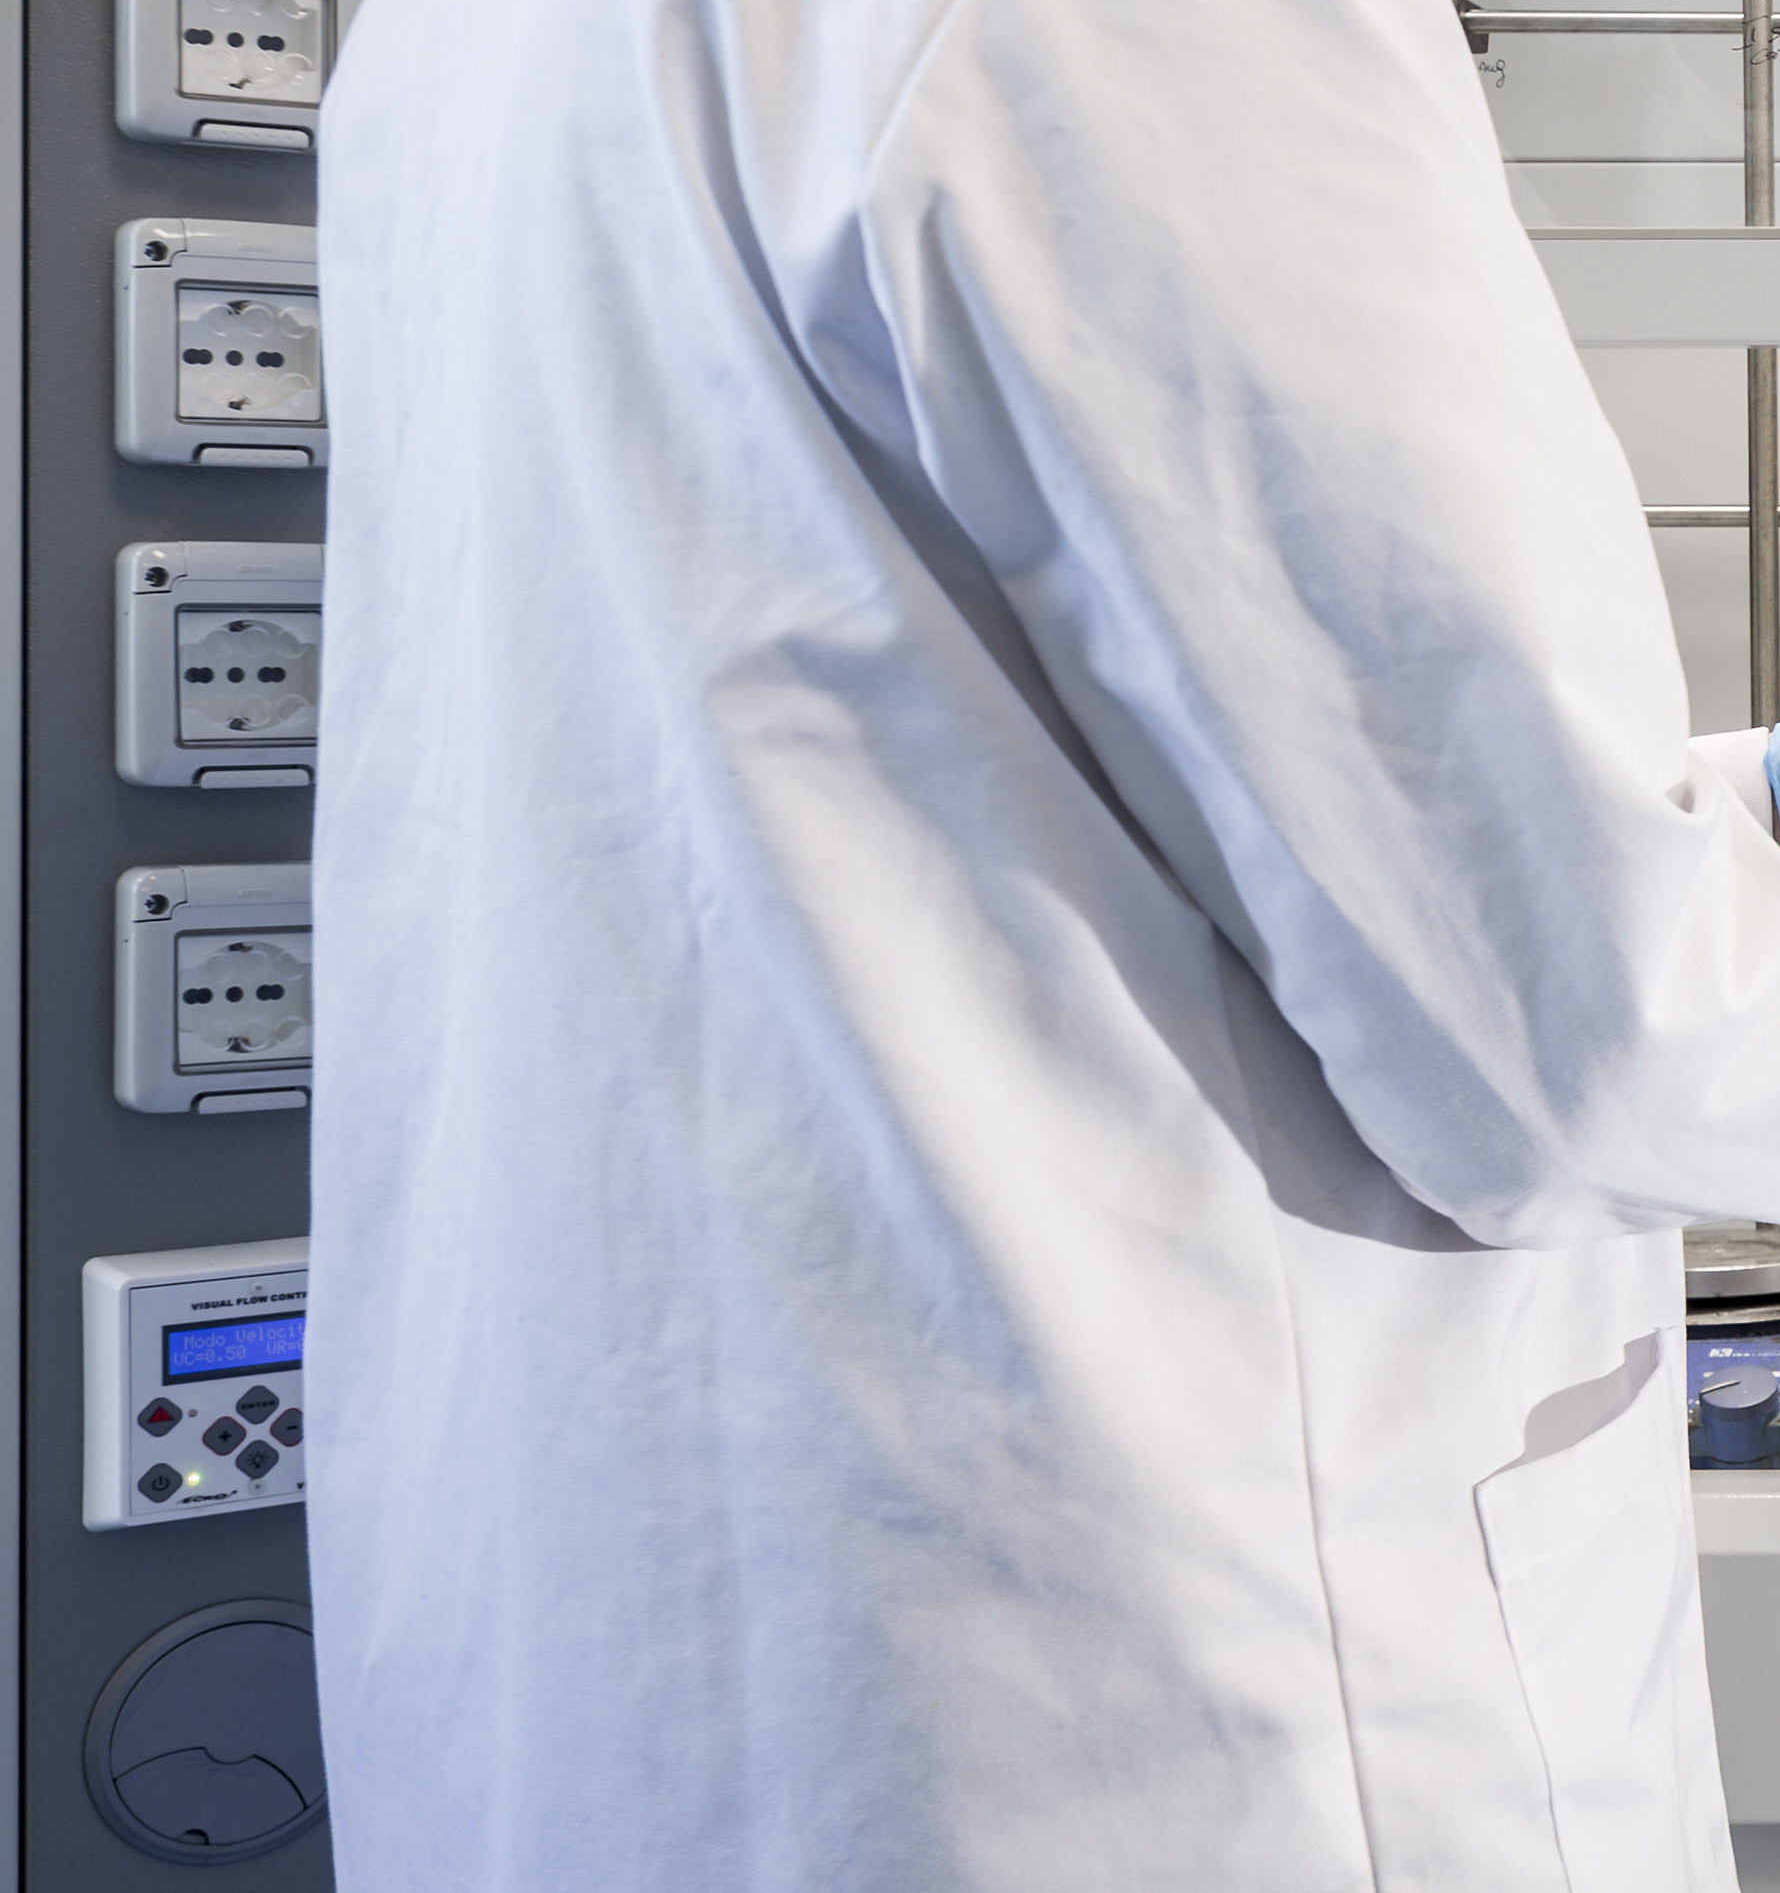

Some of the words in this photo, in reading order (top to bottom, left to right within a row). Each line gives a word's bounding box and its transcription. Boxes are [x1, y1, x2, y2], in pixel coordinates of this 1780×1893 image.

[191, 1299, 234, 1310] VISUAL
[236, 1295, 269, 1306] FLOW
[184, 1330, 225, 1348] Modo
